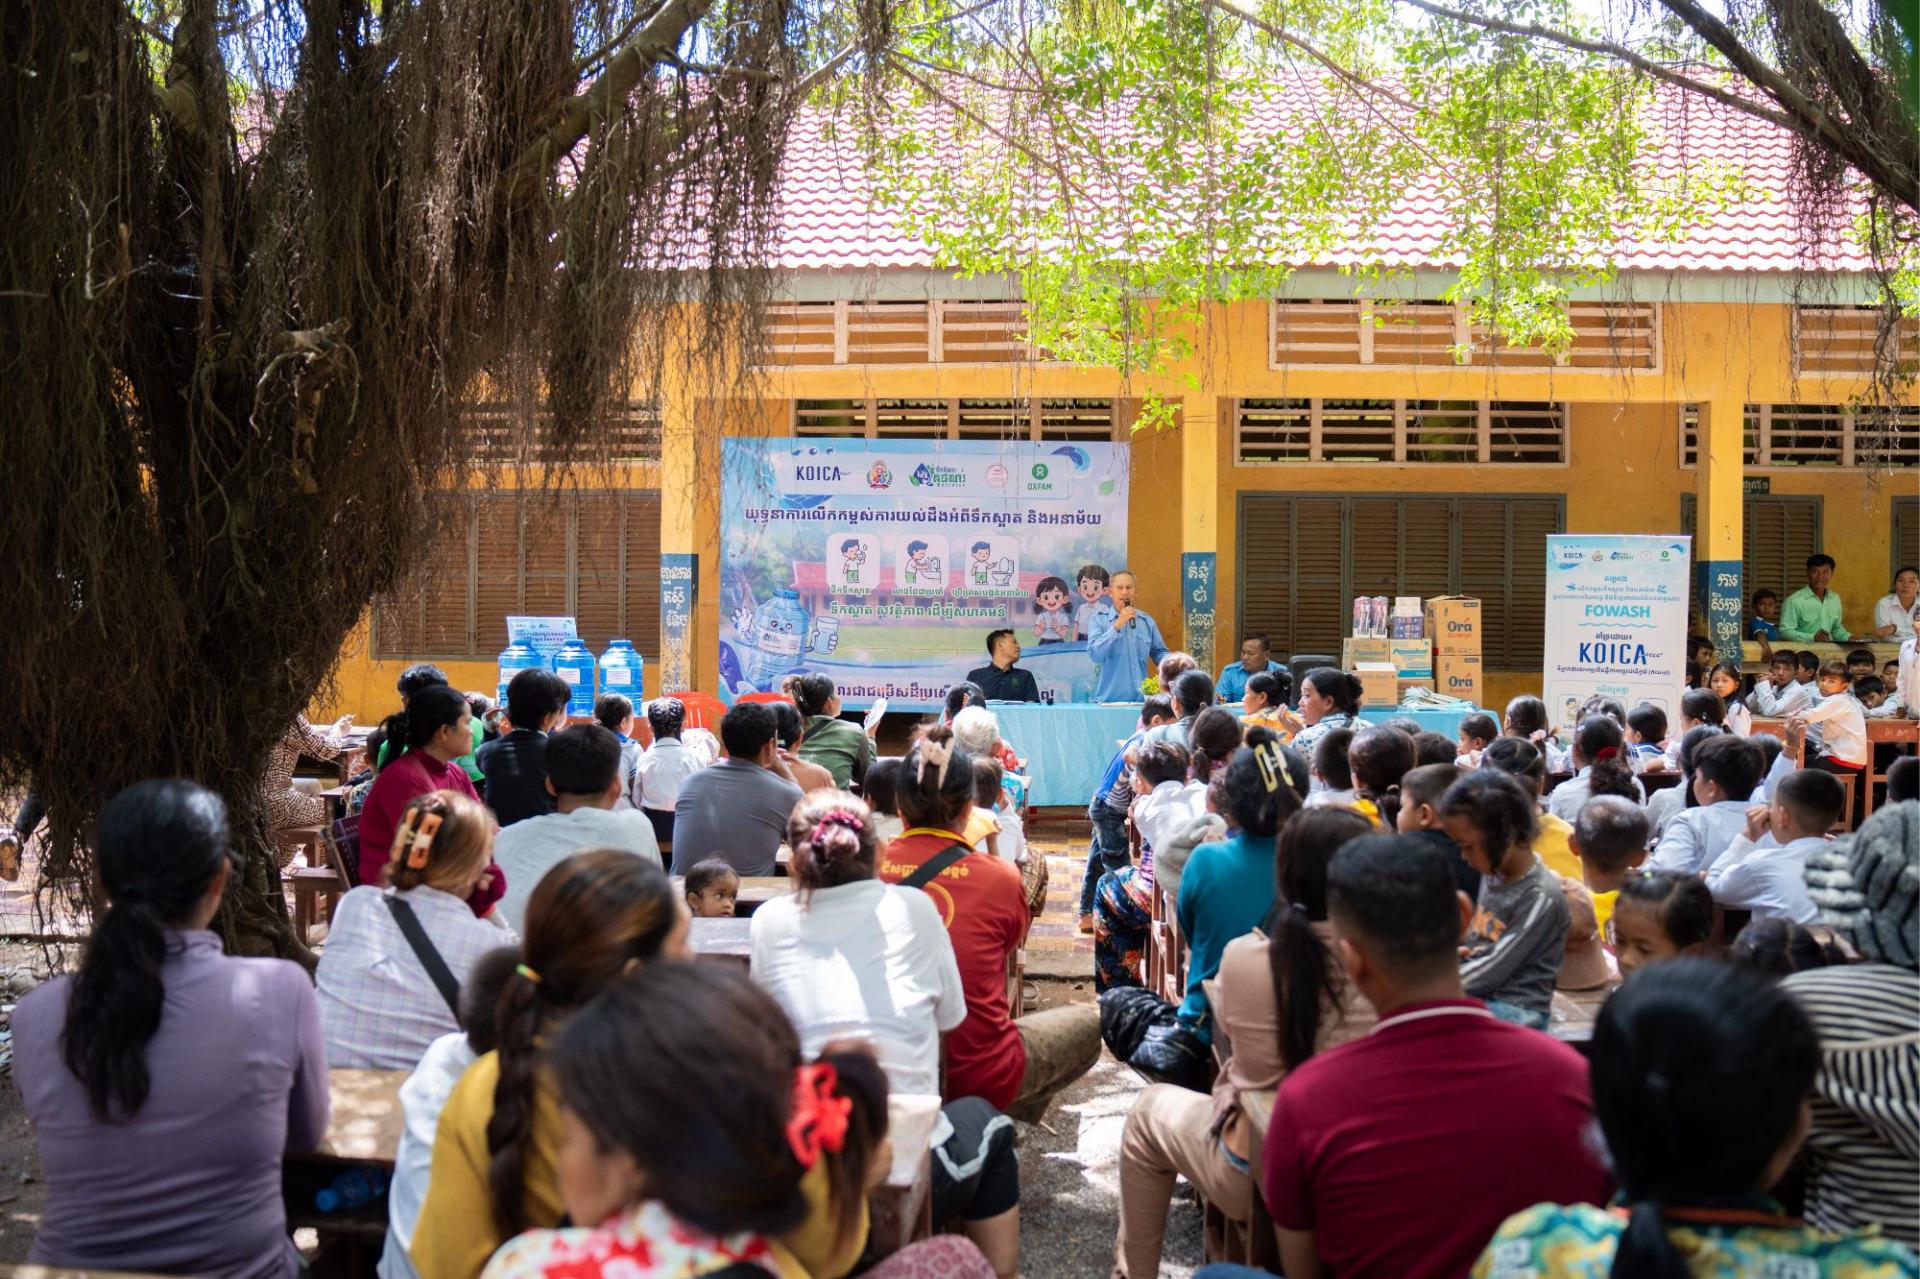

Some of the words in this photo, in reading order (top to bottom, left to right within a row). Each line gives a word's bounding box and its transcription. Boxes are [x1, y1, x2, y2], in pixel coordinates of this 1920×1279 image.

[796, 465, 841, 482] KOICA
[1027, 483, 1052, 491] OXFAM
[1027, 509, 1102, 525] និងអនាម័យ
[1585, 604, 1651, 618] FOWASH
[1447, 620, 1472, 632] Ora
[1579, 642, 1647, 665] KOICA
[1448, 676, 1473, 687] Ora
